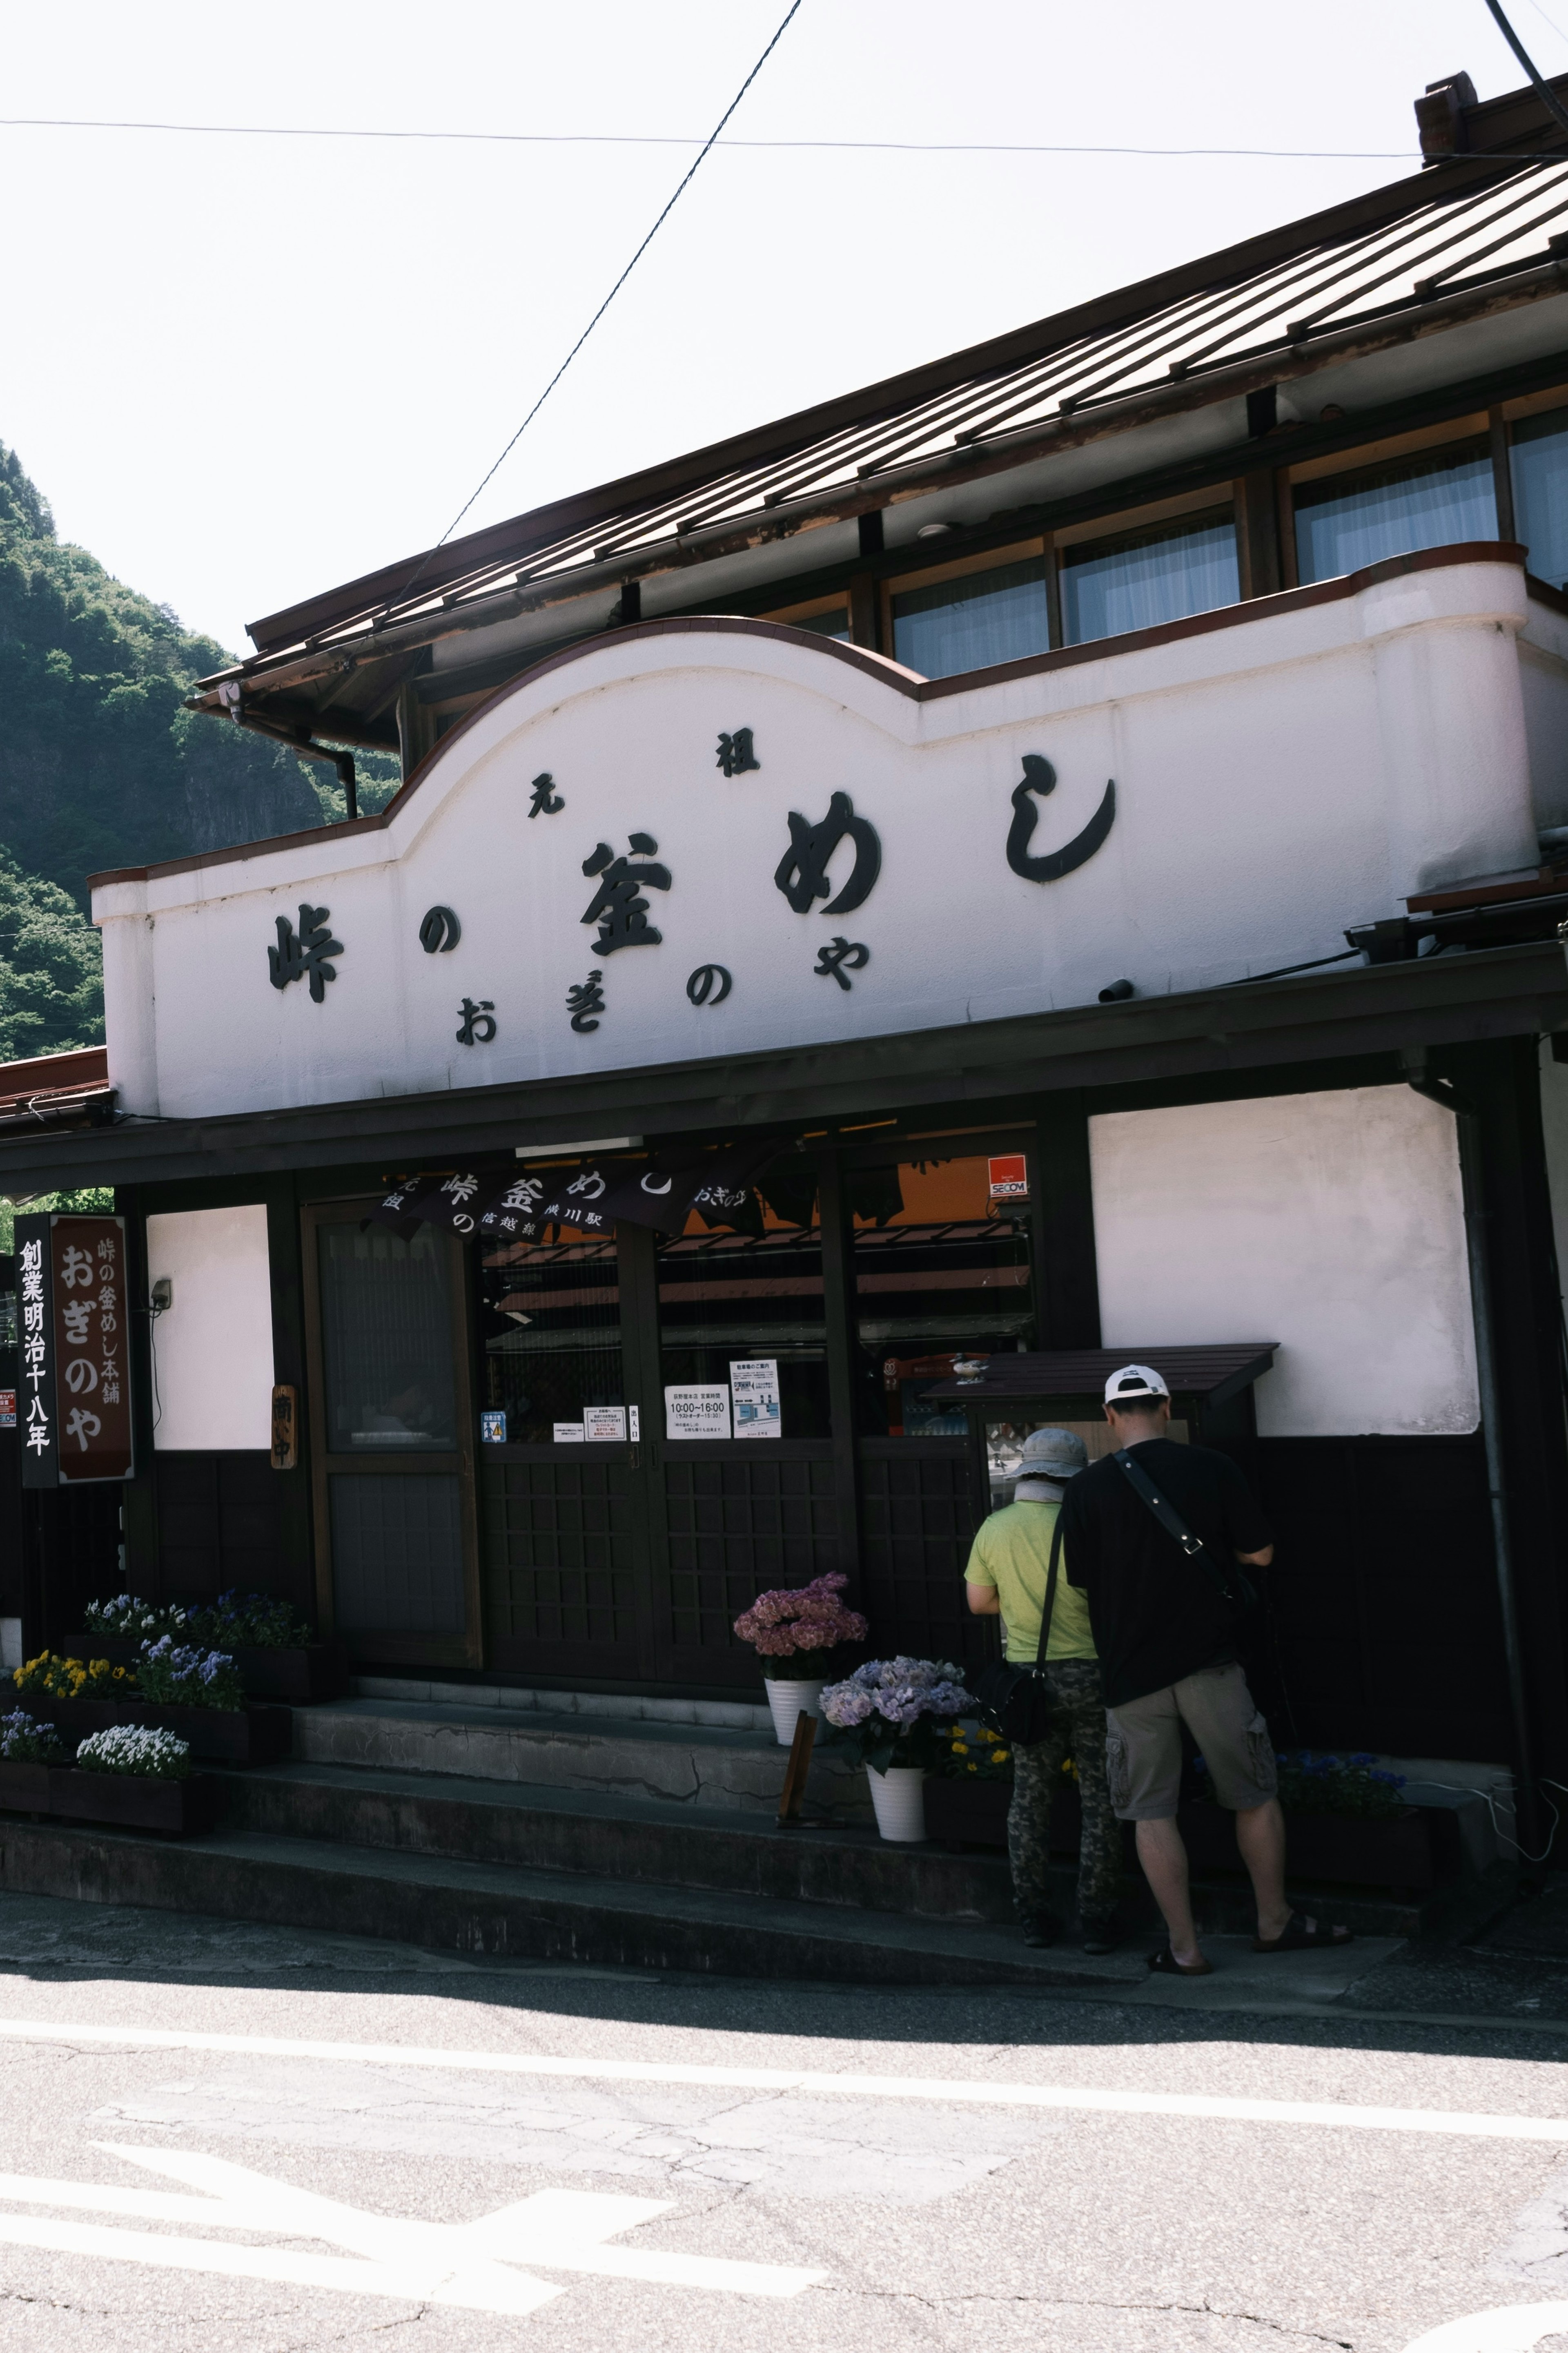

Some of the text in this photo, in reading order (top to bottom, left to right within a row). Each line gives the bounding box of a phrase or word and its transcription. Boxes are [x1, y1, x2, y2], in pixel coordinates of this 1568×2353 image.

[528, 727, 761, 819] 元祖
[267, 754, 1116, 1004] 峠の釜めし
[456, 936, 870, 1047] おぎのや
[993, 1182, 1024, 1193] SECOM
[20, 1239, 50, 1456] 創業明治十八年
[61, 1245, 101, 1452] おぎのや
[98, 1238, 120, 1404] 峠の釜めし本舗
